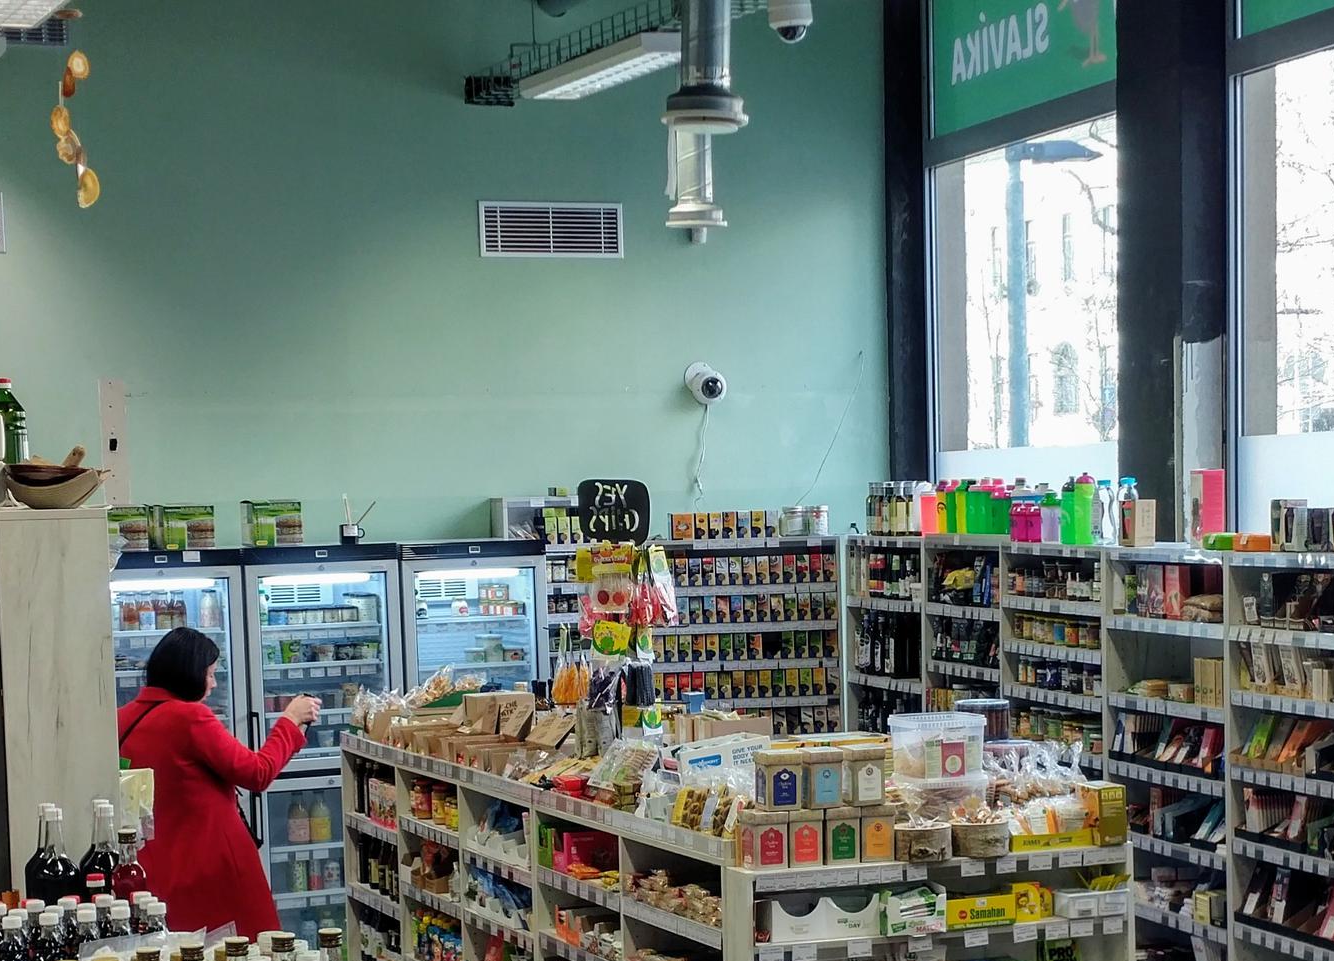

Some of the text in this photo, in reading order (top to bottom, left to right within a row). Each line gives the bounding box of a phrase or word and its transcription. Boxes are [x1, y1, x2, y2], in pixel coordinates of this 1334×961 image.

[747, 743, 763, 752] YOUR
[969, 907, 1007, 920] Samahan
[1049, 948, 1074, 961] PRO
